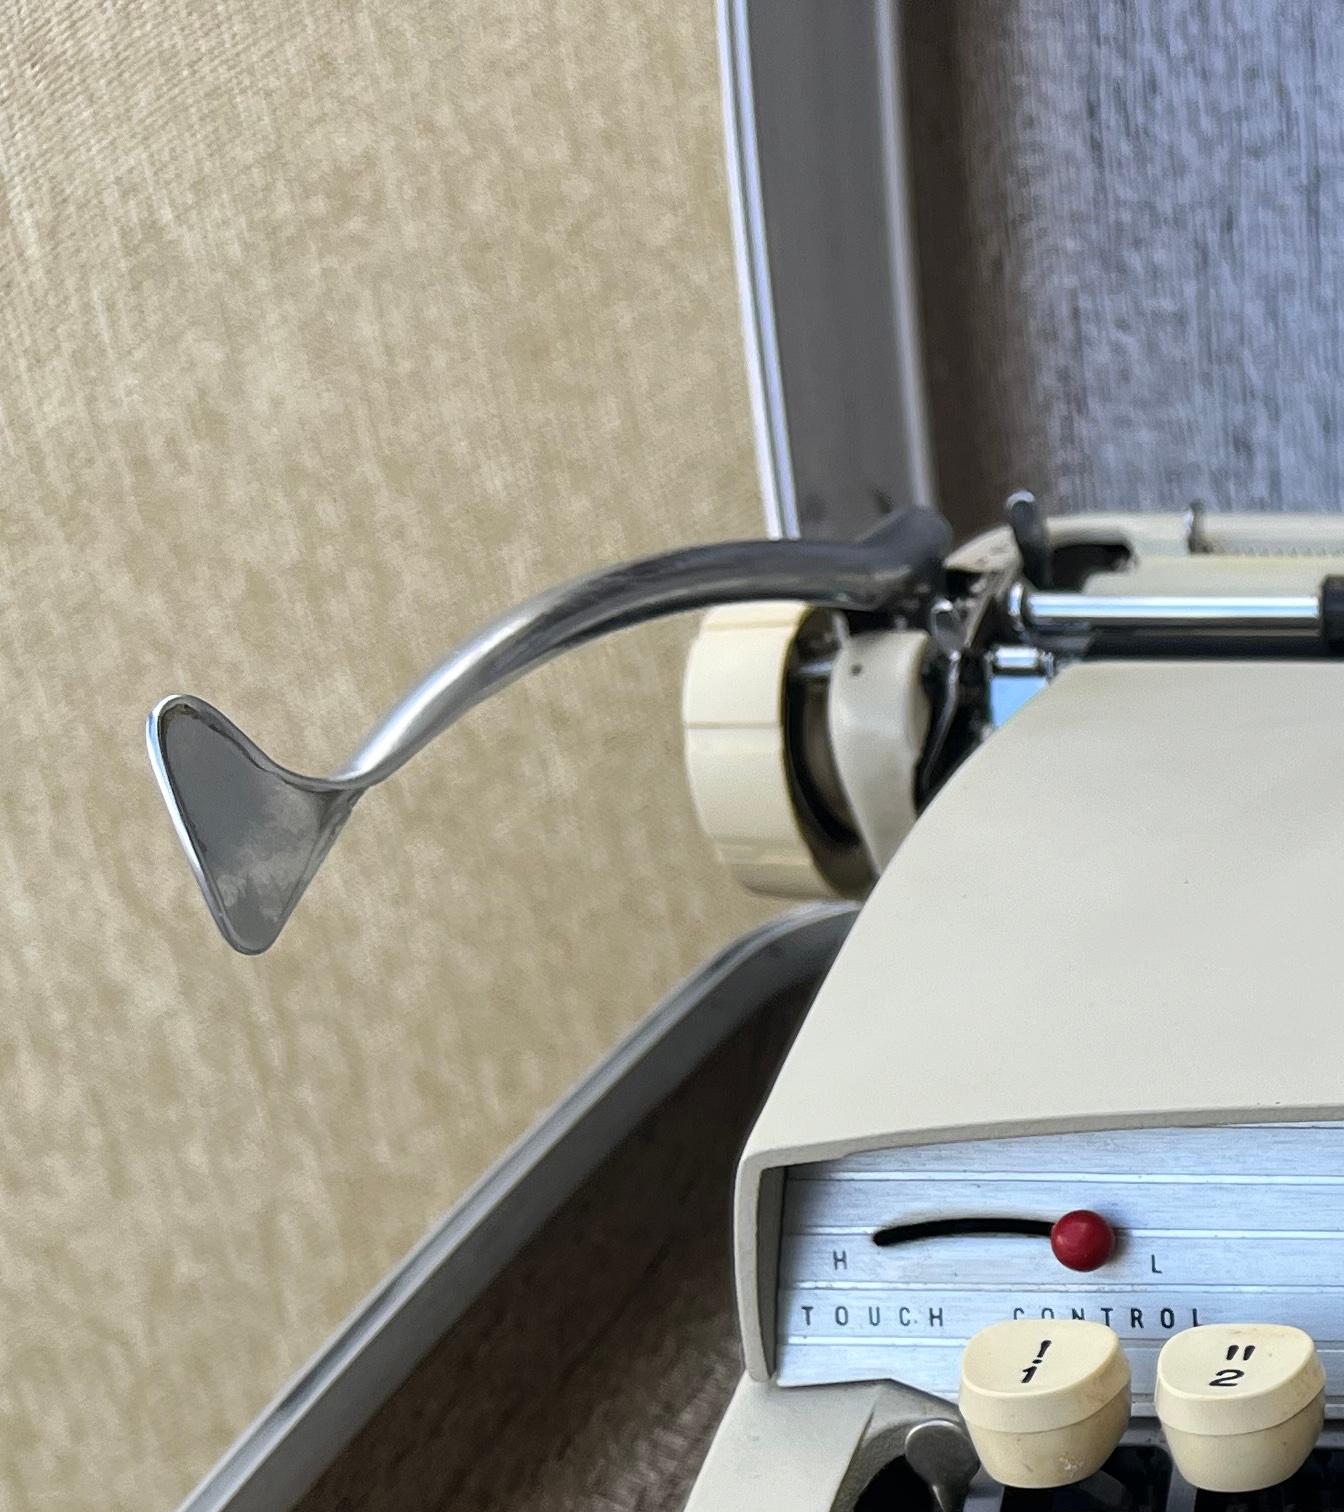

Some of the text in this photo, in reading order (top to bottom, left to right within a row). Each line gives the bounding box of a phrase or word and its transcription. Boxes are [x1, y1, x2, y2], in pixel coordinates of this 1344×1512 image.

[833, 1251, 846, 1269] H
[1152, 1255, 1162, 1273] L
[801, 1306, 944, 1327] TOUCH
[1033, 1339, 1052, 1365] !
[1021, 1365, 1038, 1384] 1
[1208, 1369, 1245, 1387] 2
